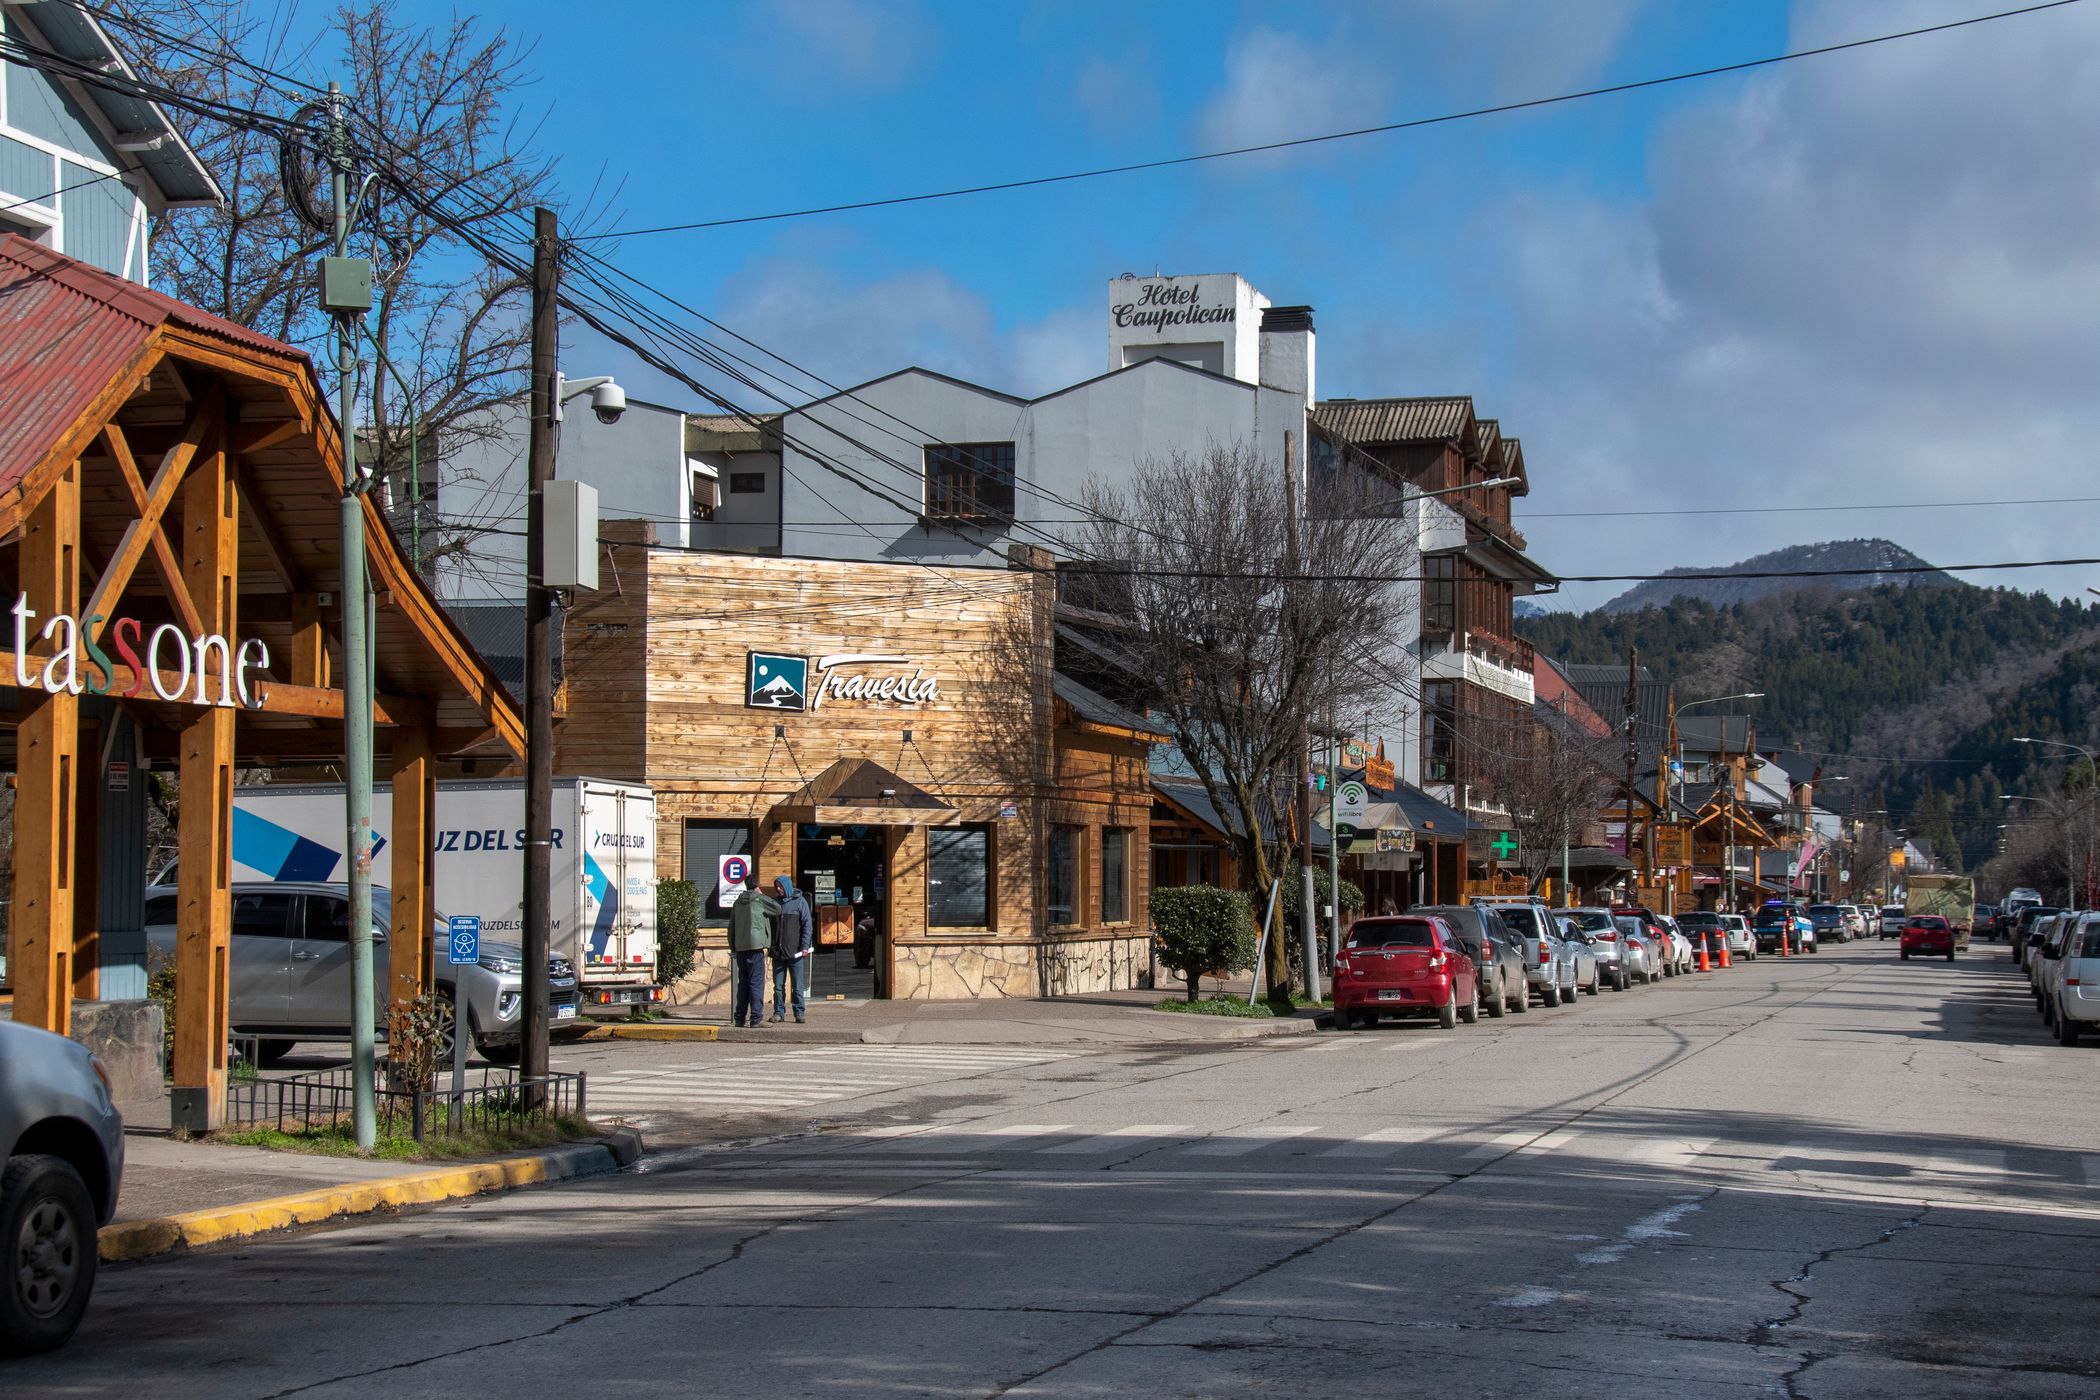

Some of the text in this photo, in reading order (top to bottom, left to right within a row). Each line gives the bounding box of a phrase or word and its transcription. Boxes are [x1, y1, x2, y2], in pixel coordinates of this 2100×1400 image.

[1138, 284, 1200, 306] Hotel
[1112, 304, 1236, 333] Caupolicán
[11, 591, 270, 709] tassone
[811, 654, 941, 711] Travesía
[463, 829, 509, 851] DEL
[514, 829, 564, 850] SR
[633, 836, 645, 848] SUR
[730, 863, 741, 878] E
